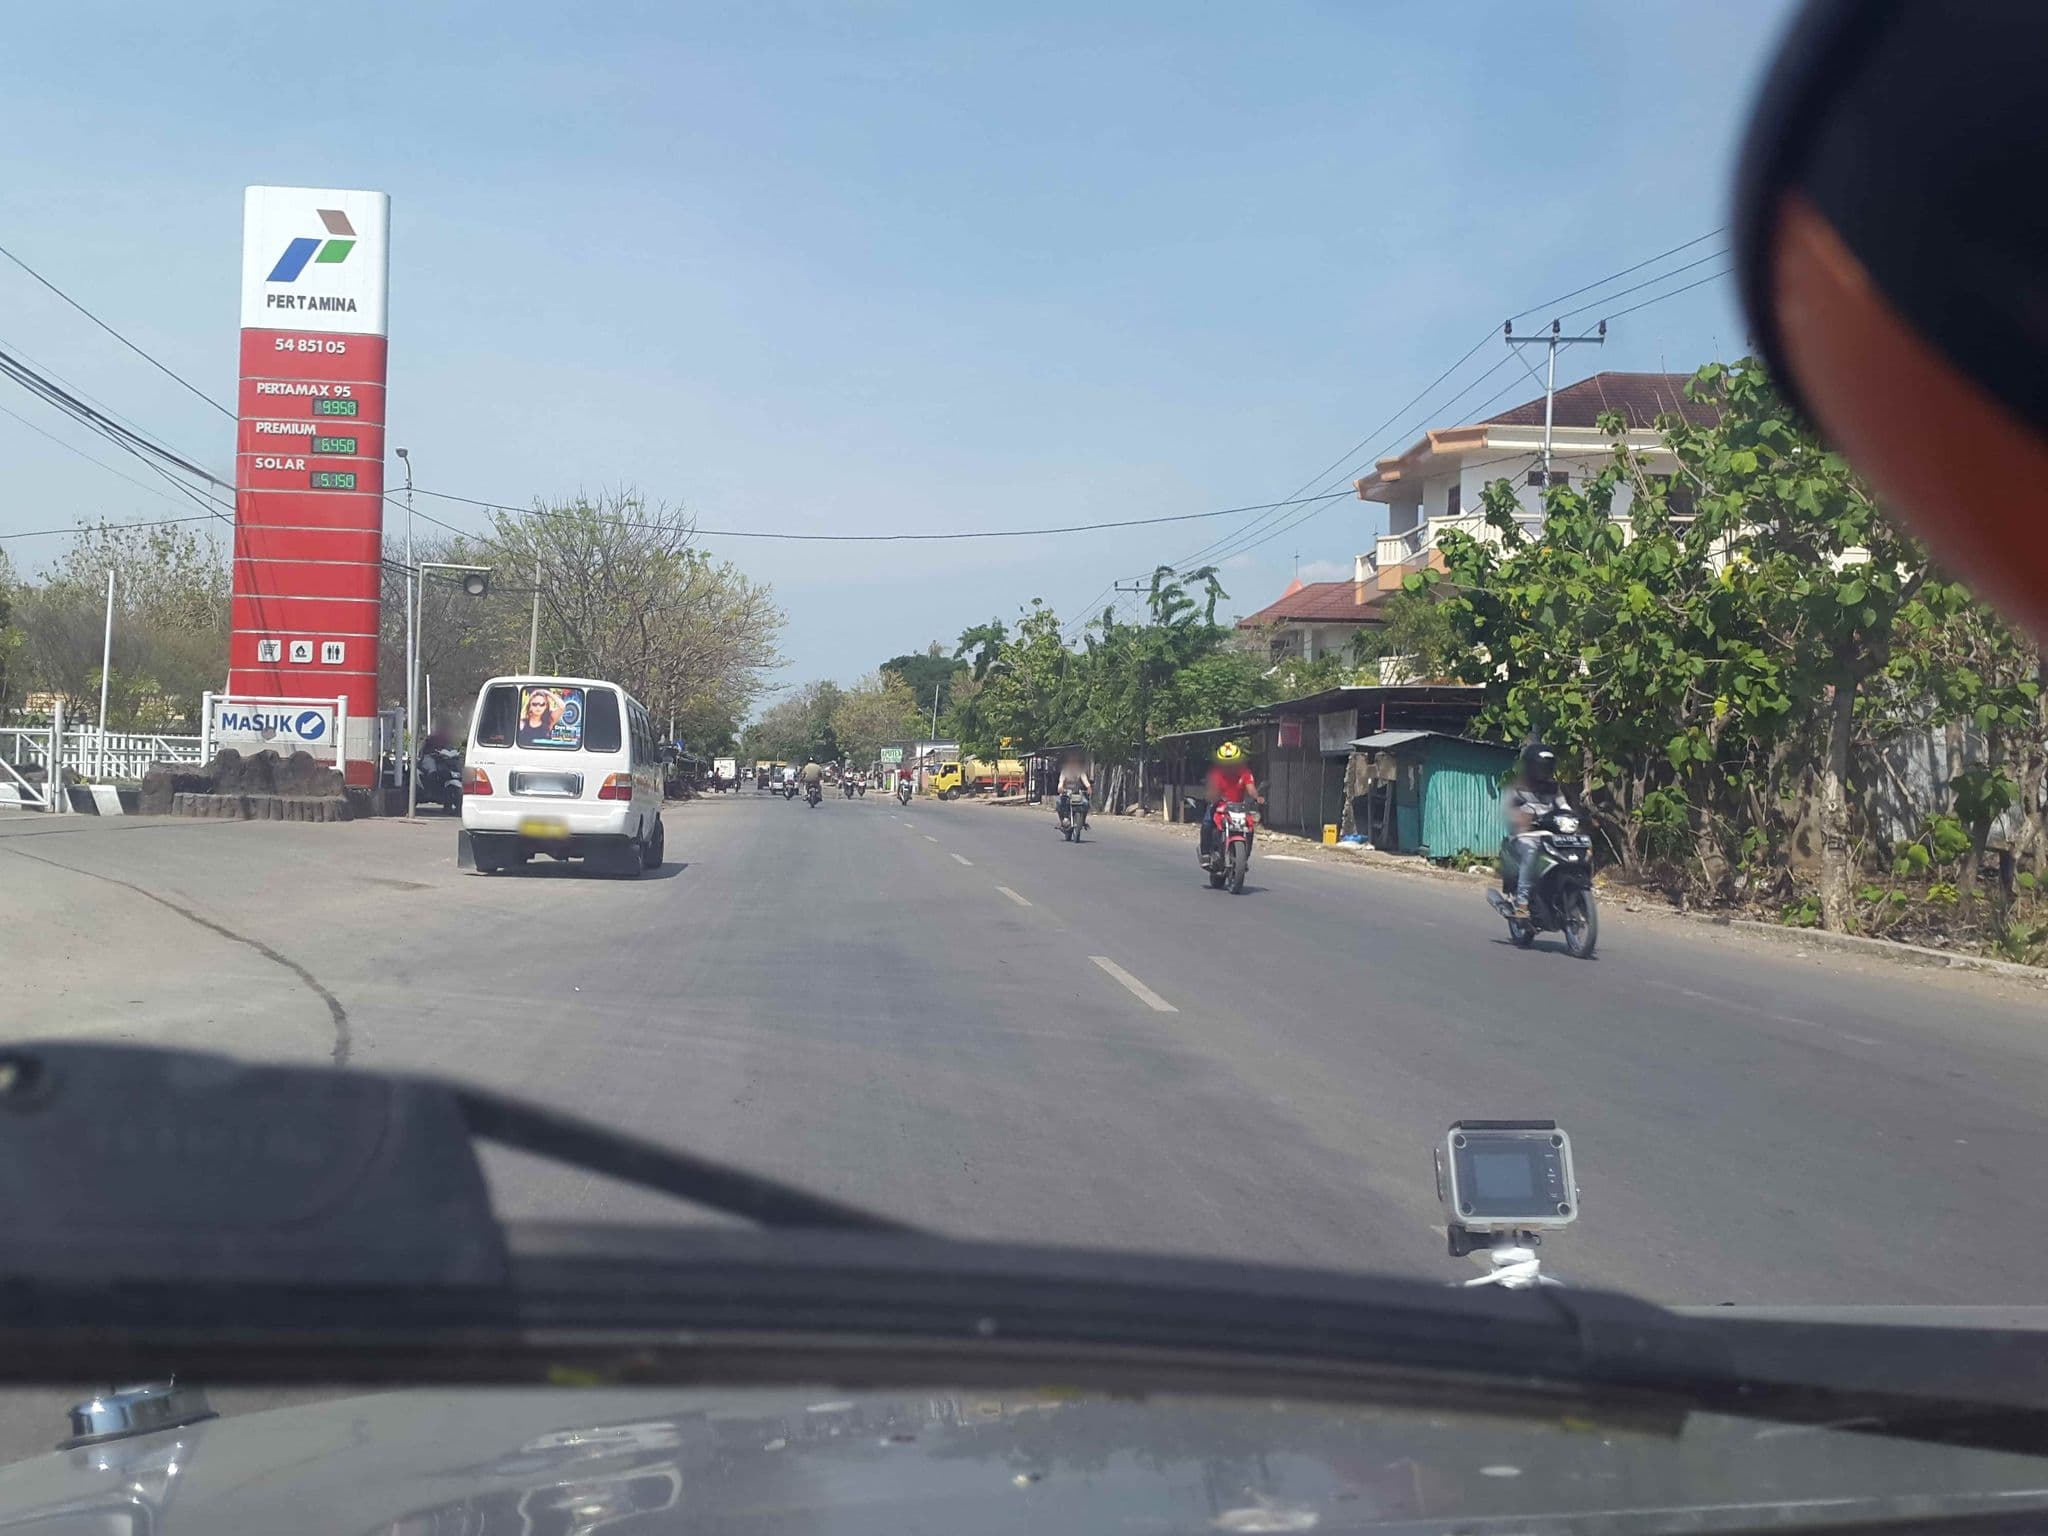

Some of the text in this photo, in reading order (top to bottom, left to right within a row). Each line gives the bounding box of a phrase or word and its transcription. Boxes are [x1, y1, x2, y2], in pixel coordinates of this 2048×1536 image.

[267, 294, 357, 312] PERTAMINA
[275, 338, 346, 354] 54 851 05
[257, 383, 351, 397] PERTAMAX 95
[256, 422, 316, 435] PREMIUM
[255, 458, 305, 470] SOLAR
[222, 712, 292, 732] MASUK
